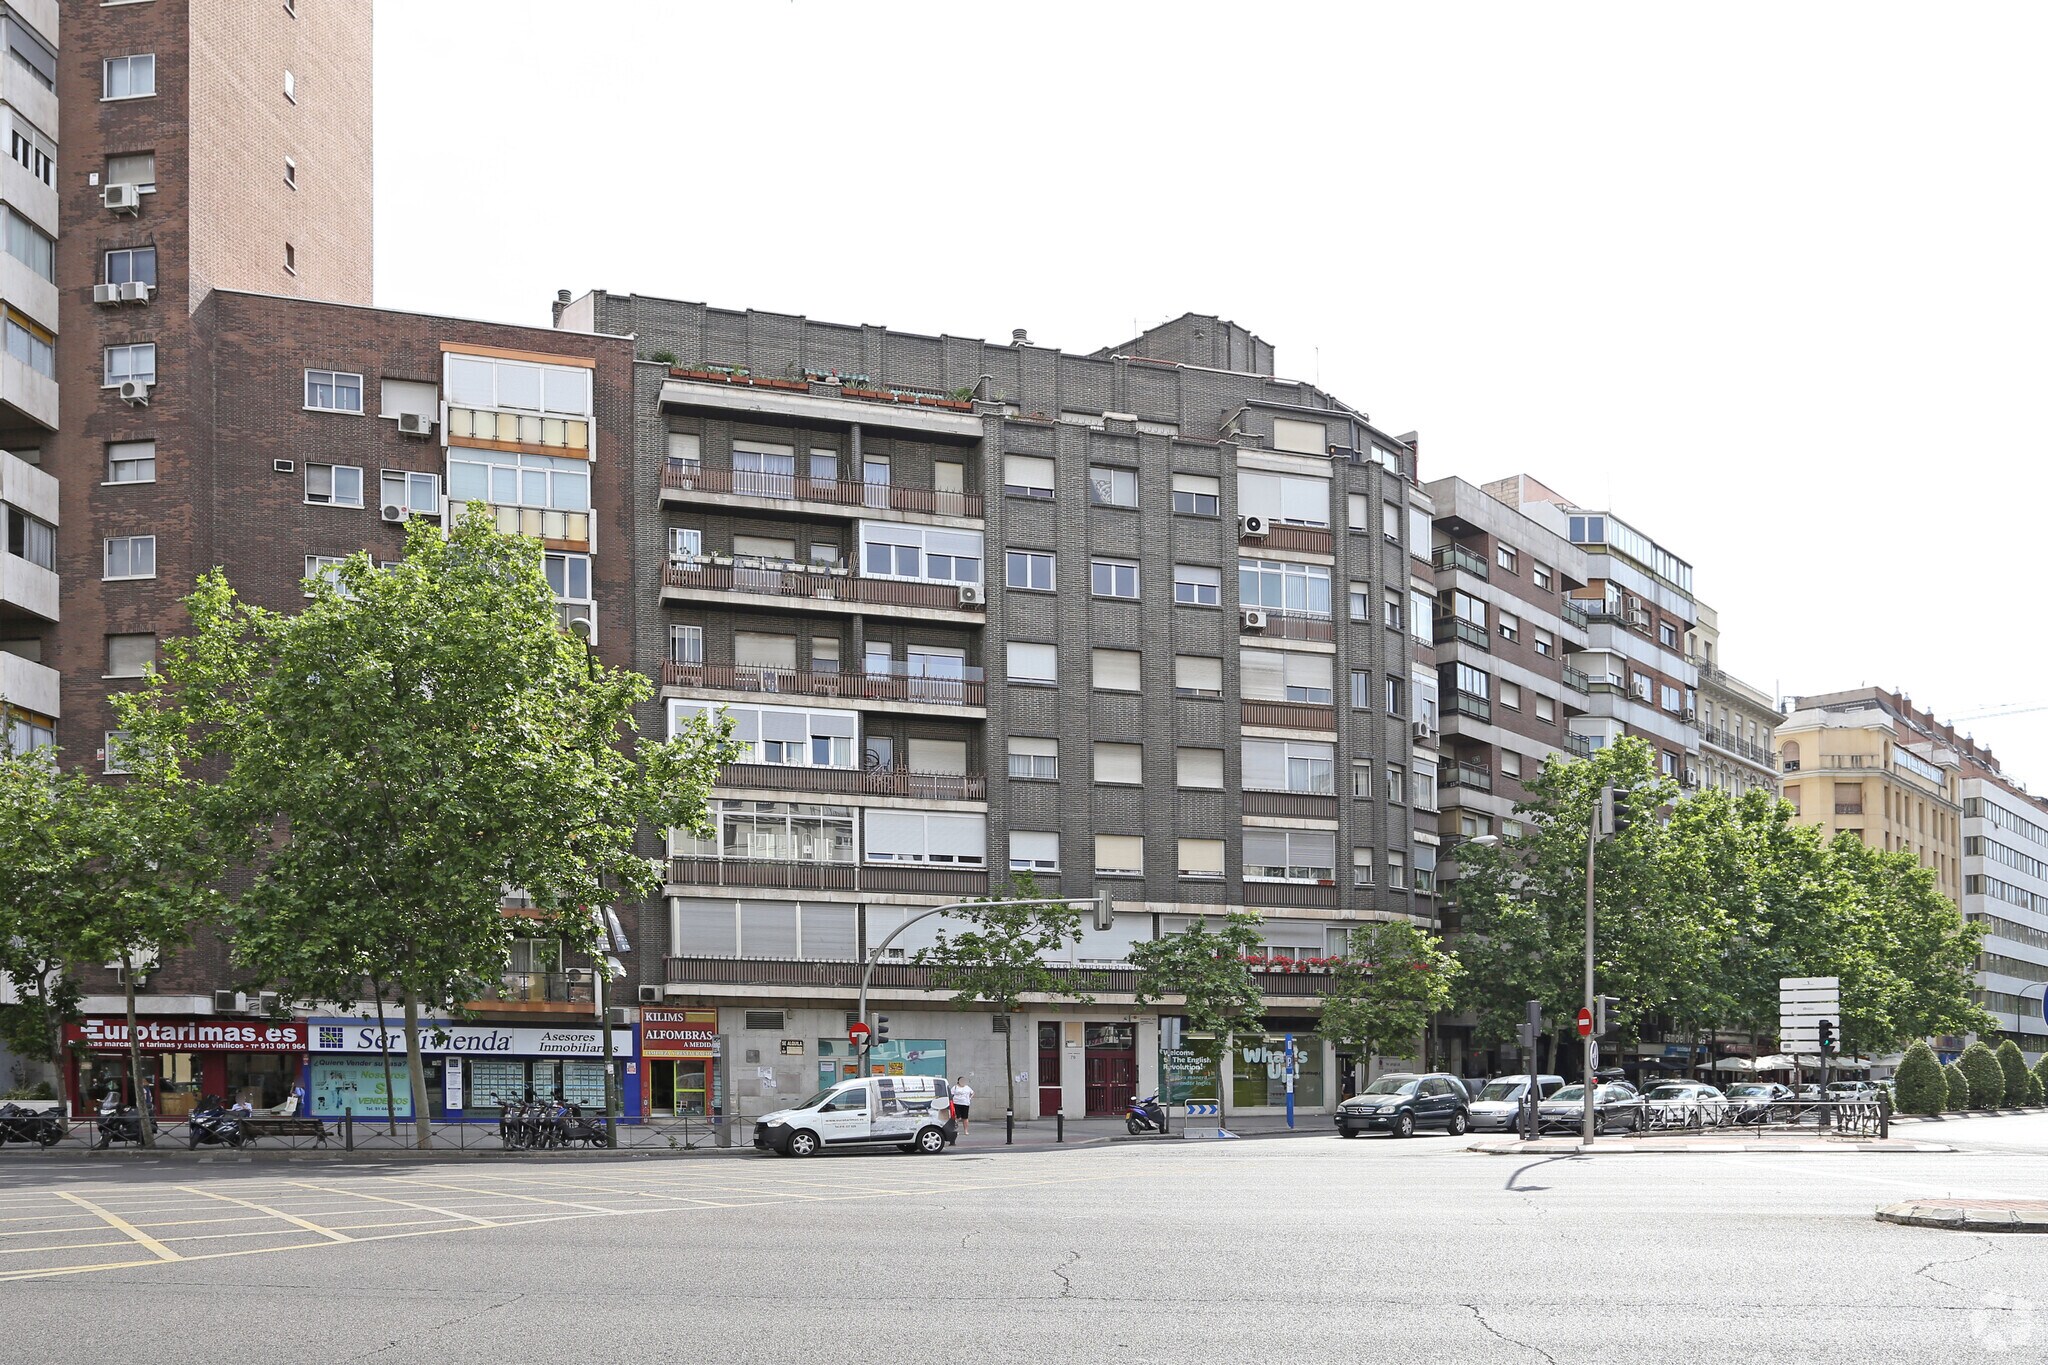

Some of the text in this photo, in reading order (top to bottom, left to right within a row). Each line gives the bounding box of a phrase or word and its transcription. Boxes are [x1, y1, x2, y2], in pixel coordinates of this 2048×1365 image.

[645, 1012, 684, 1022] KILIMS
[80, 1020, 298, 1043] Eurotarimas.es
[645, 1030, 713, 1040] ALFOMBRAS
[541, 1032, 596, 1042] Asesores
[539, 1042, 619, 1053] Inmobiliars
[1243, 1047, 1308, 1063] Wha's
[1187, 1056, 1212, 1065] English
[1162, 1063, 1204, 1071] Rvolution!
[360, 1071, 407, 1080] Nosoros
